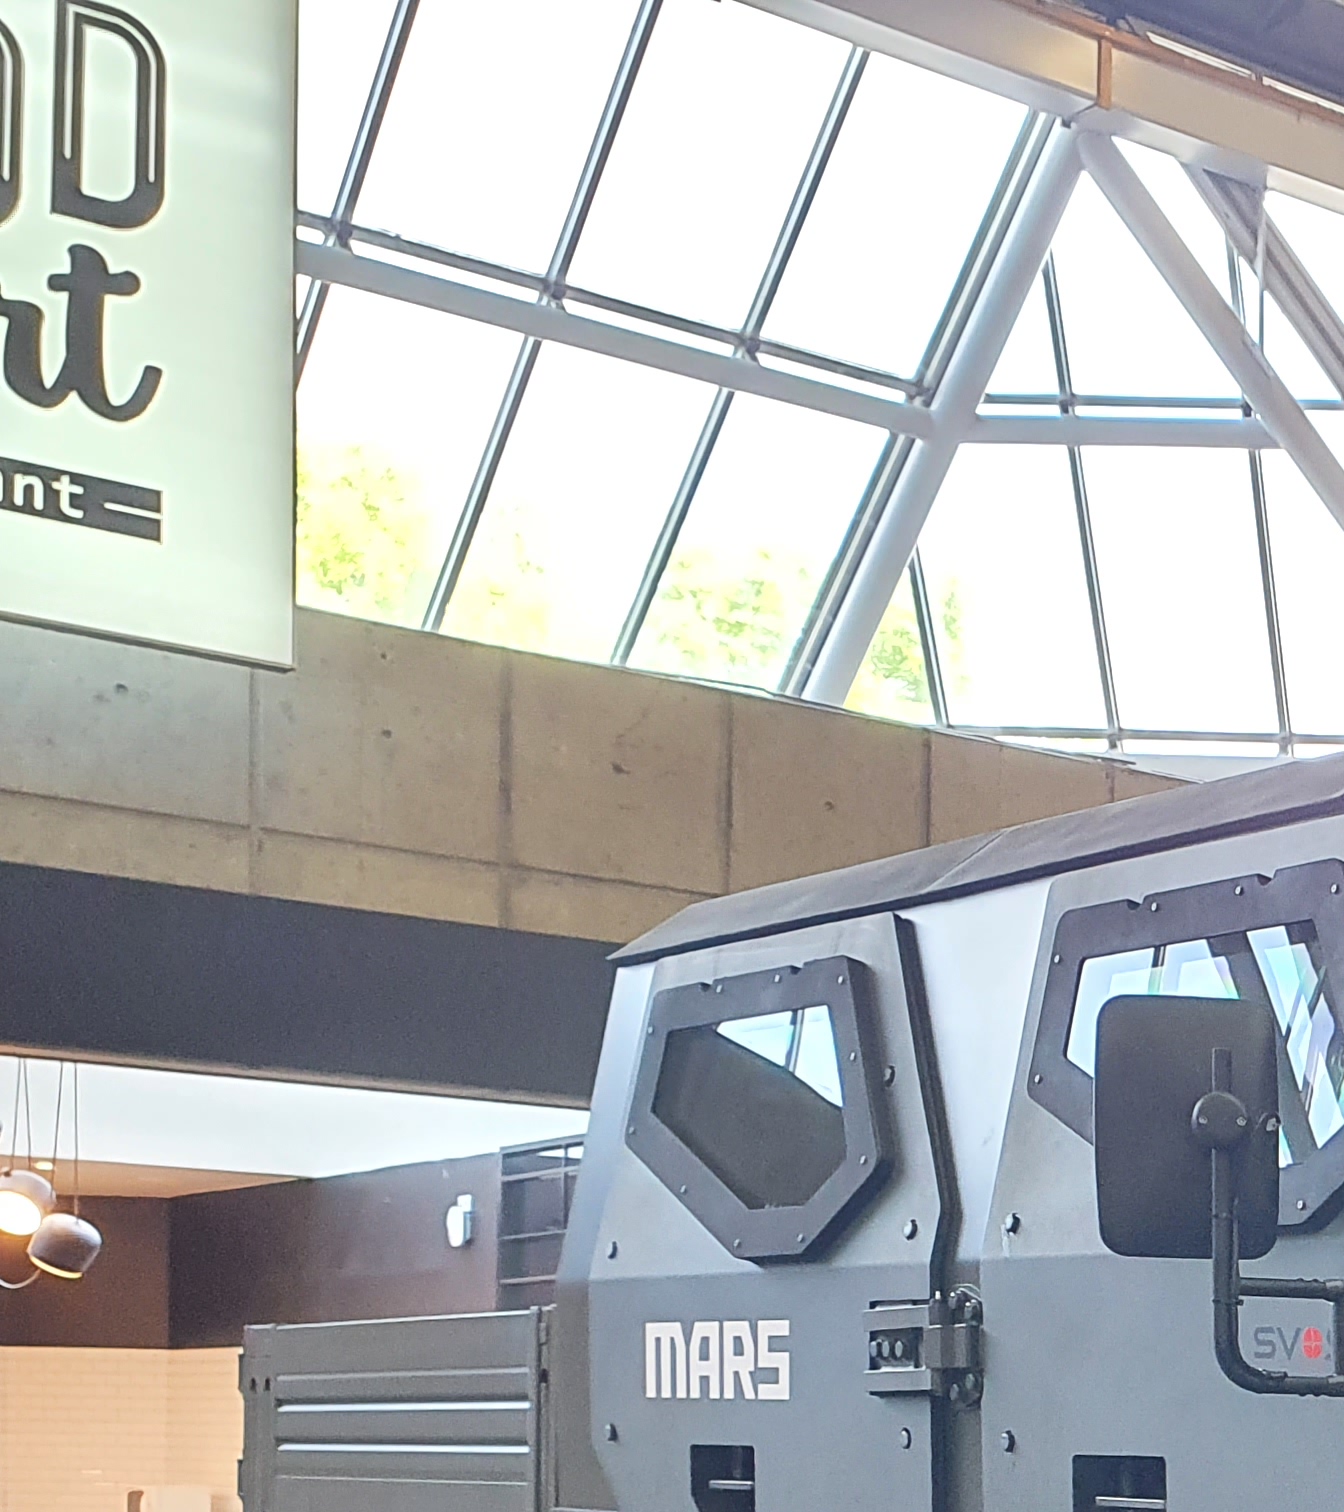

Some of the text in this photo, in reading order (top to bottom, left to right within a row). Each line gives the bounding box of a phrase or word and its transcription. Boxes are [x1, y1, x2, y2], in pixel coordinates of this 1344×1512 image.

[0, 0, 167, 229] D
[0, 470, 85, 520] nt
[645, 1319, 790, 1400] MARS
[1253, 1325, 1334, 1361] SVO
